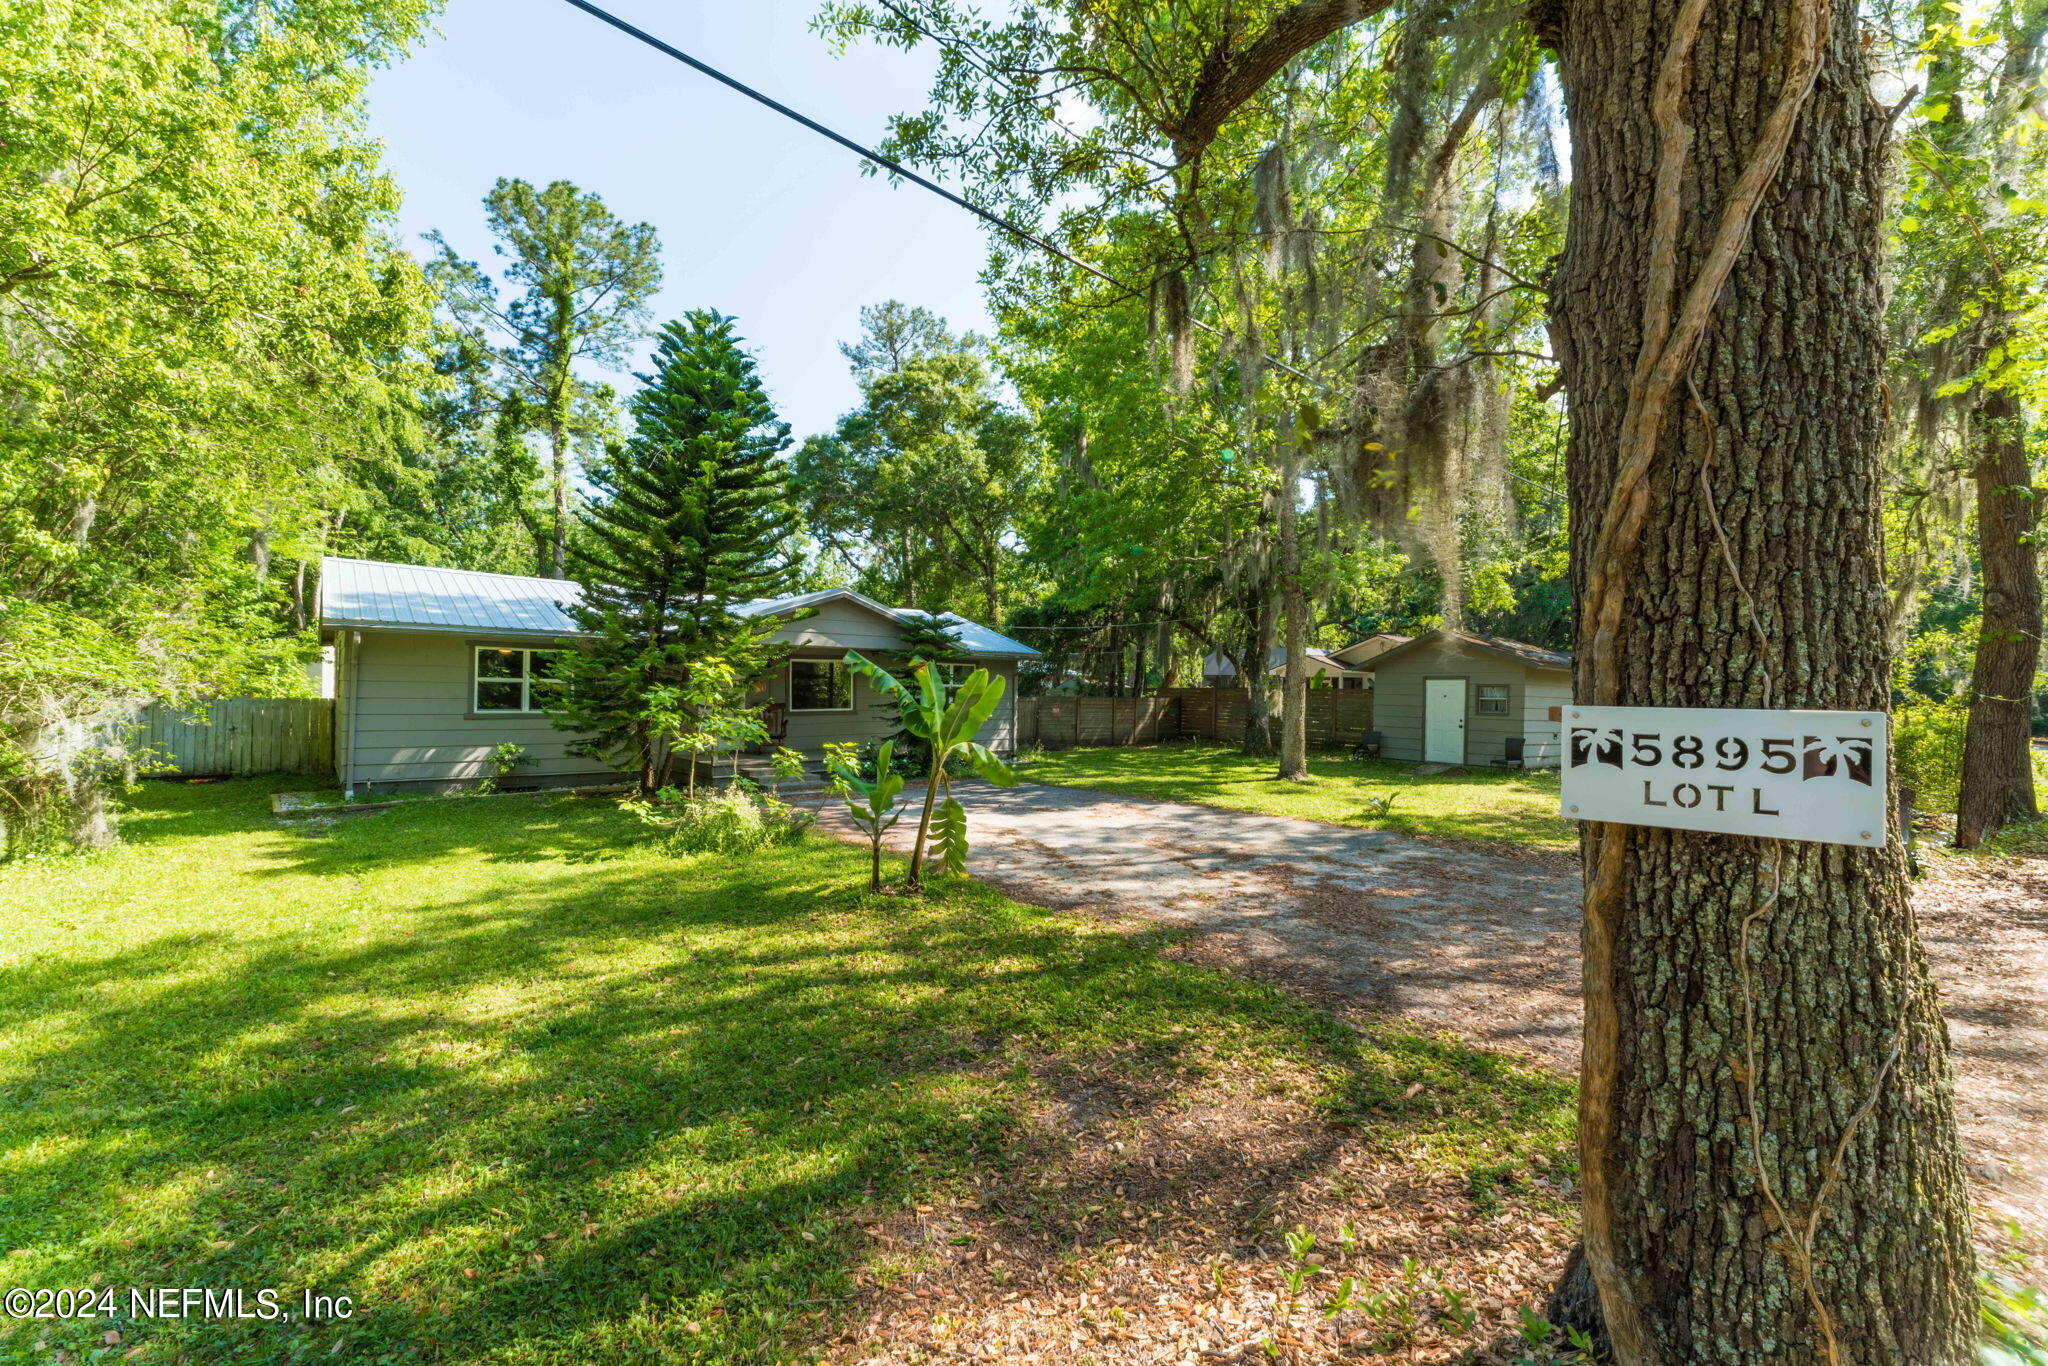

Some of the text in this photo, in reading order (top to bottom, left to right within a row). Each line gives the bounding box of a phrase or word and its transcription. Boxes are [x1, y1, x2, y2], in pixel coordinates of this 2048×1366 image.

[1630, 733, 1797, 775] 5895
[1643, 780, 1780, 817] LOT L
